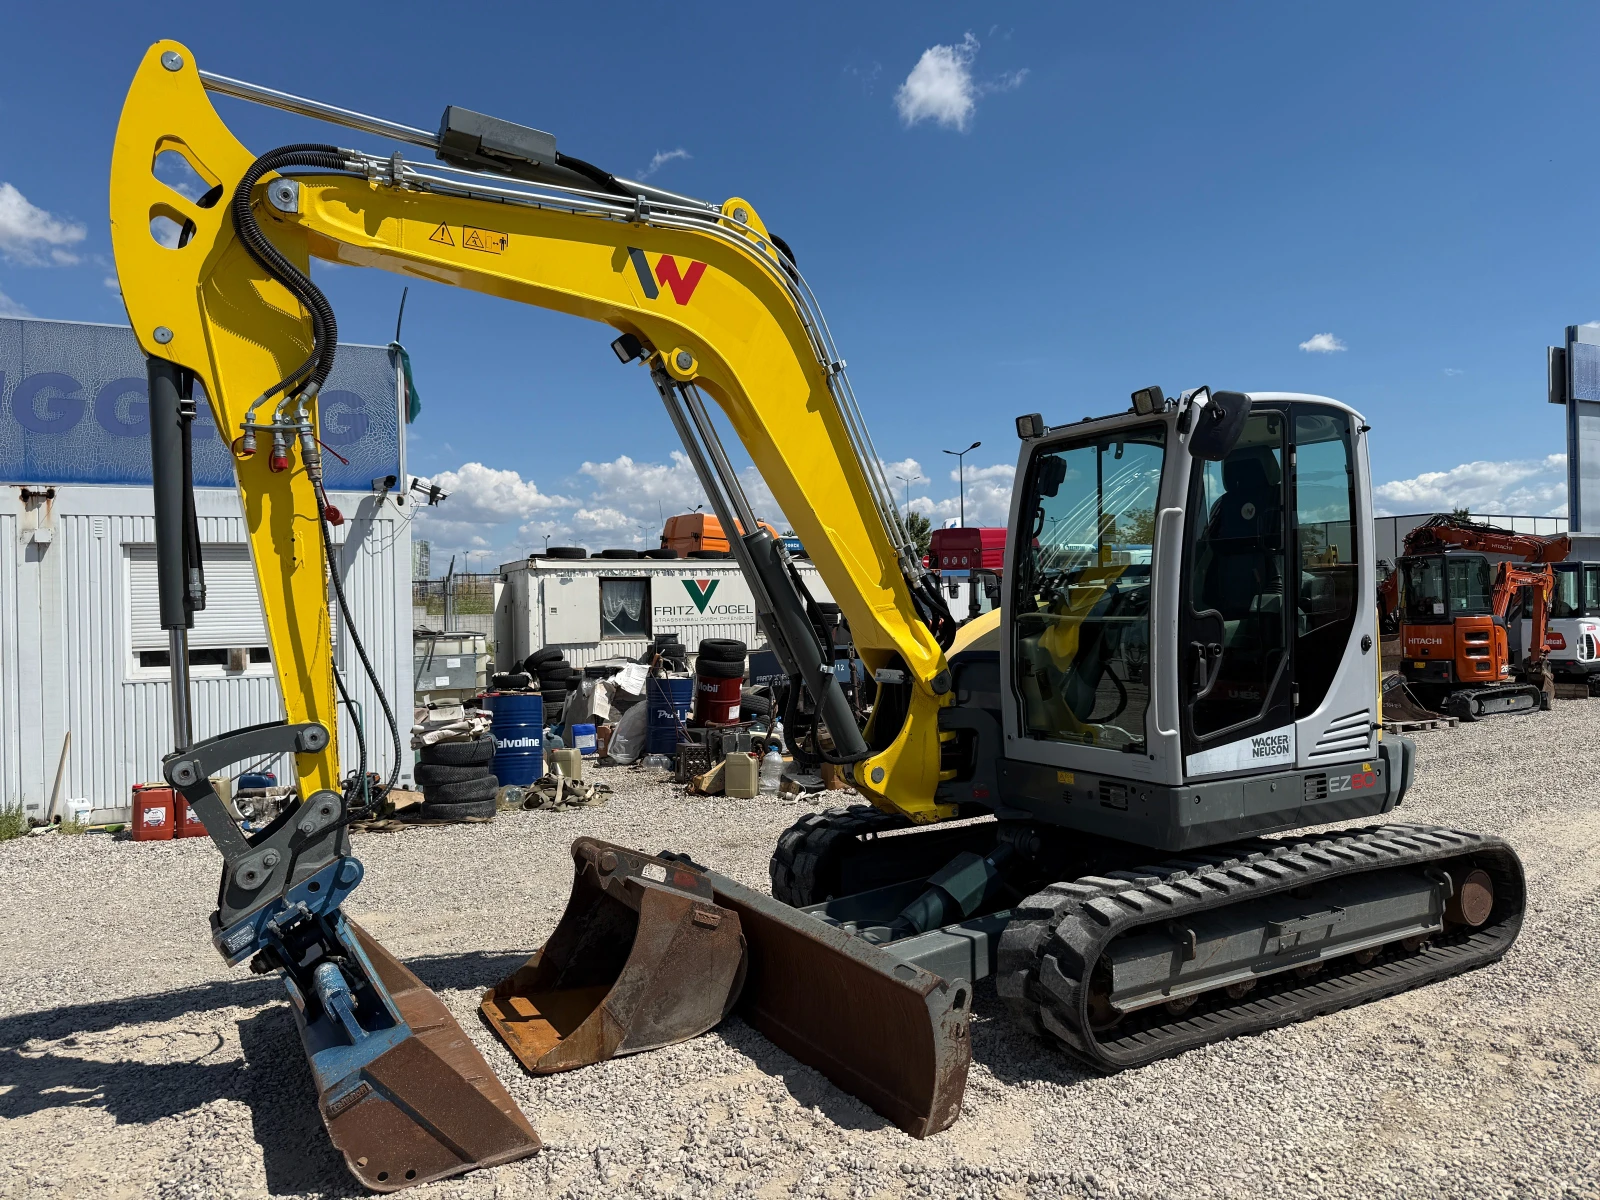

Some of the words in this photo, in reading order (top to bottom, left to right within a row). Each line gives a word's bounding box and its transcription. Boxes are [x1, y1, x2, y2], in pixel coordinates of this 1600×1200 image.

[654, 606, 694, 616] FRITZ
[709, 605, 754, 615] VOGEL
[496, 737, 541, 749] alvoline
[1251, 734, 1289, 748] WACKER
[1252, 744, 1289, 758] NEUSON
[1329, 772, 1377, 793] EZ80
